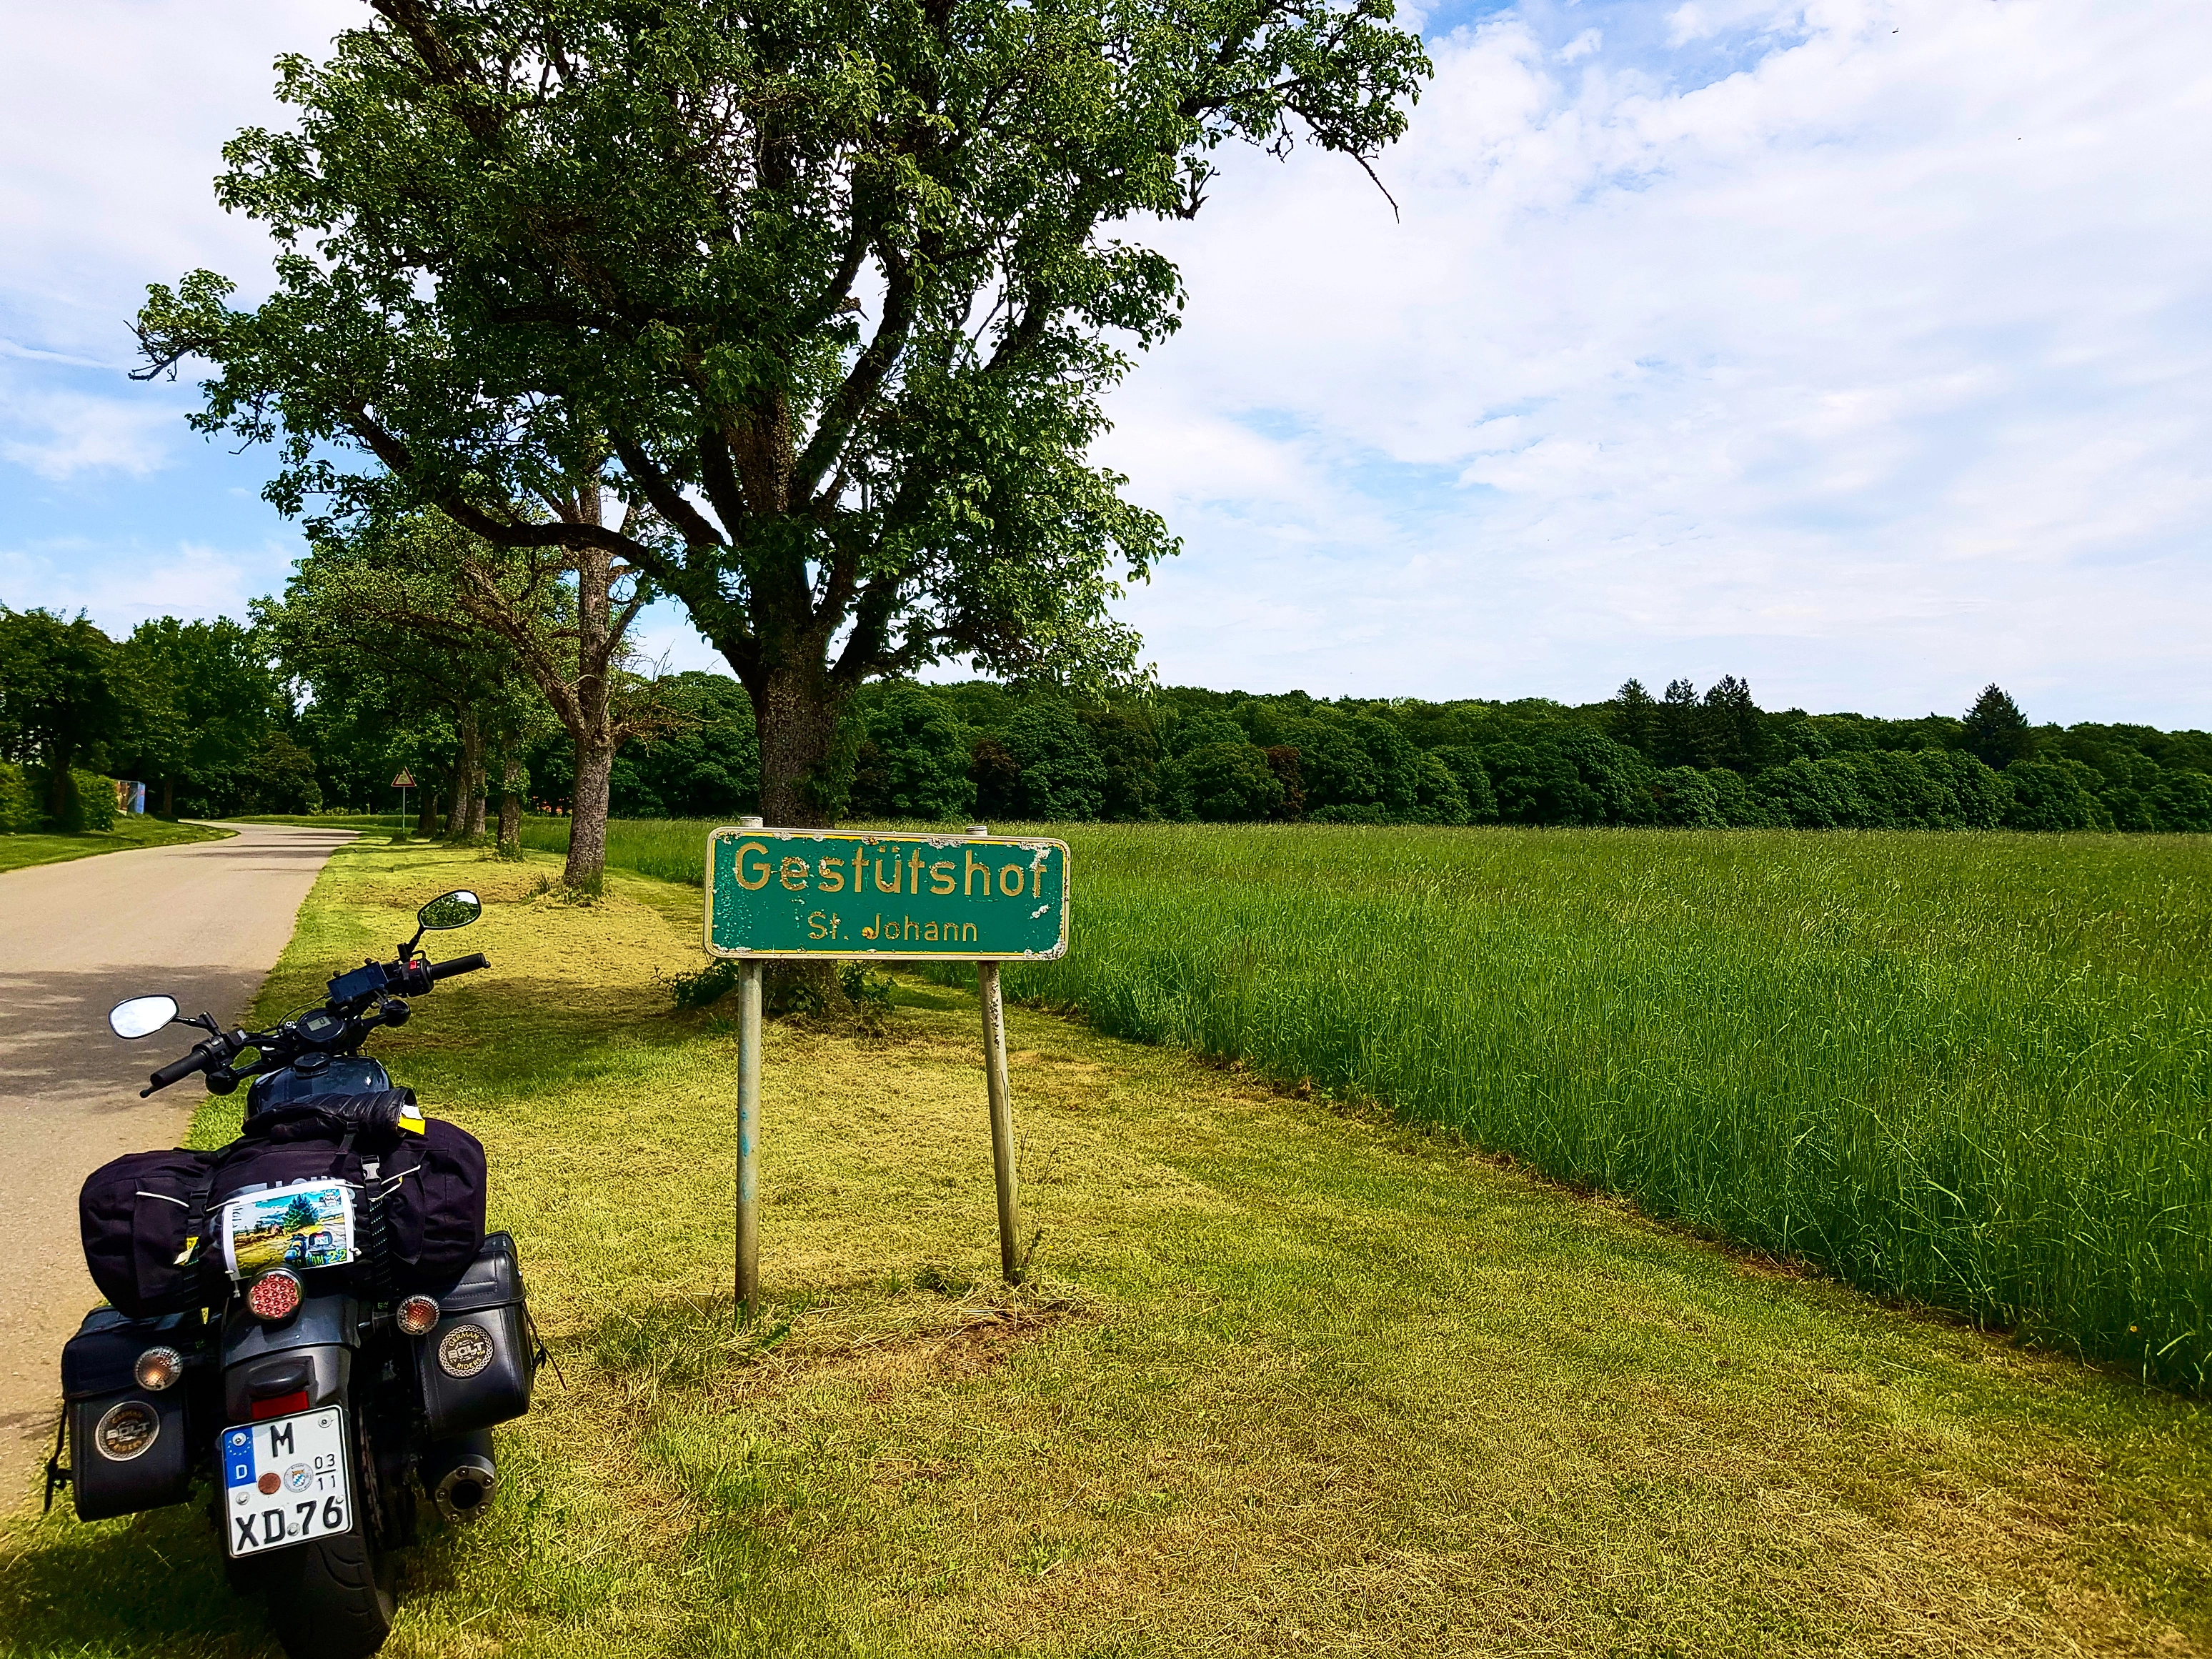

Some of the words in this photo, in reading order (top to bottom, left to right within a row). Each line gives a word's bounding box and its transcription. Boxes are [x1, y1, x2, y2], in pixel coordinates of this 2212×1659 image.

[734, 842, 1047, 898] Gestütshof
[807, 912, 849, 940] St.
[862, 914, 978, 942] Johann
[449, 1332, 479, 1347] GERMAN
[456, 1357, 482, 1370] RIDERS
[270, 1422, 294, 1458] M
[314, 1453, 335, 1470] 03
[236, 1465, 248, 1480] D
[317, 1475, 336, 1490] 11
[236, 1508, 286, 1551] XD
[297, 1495, 343, 1535] 76
